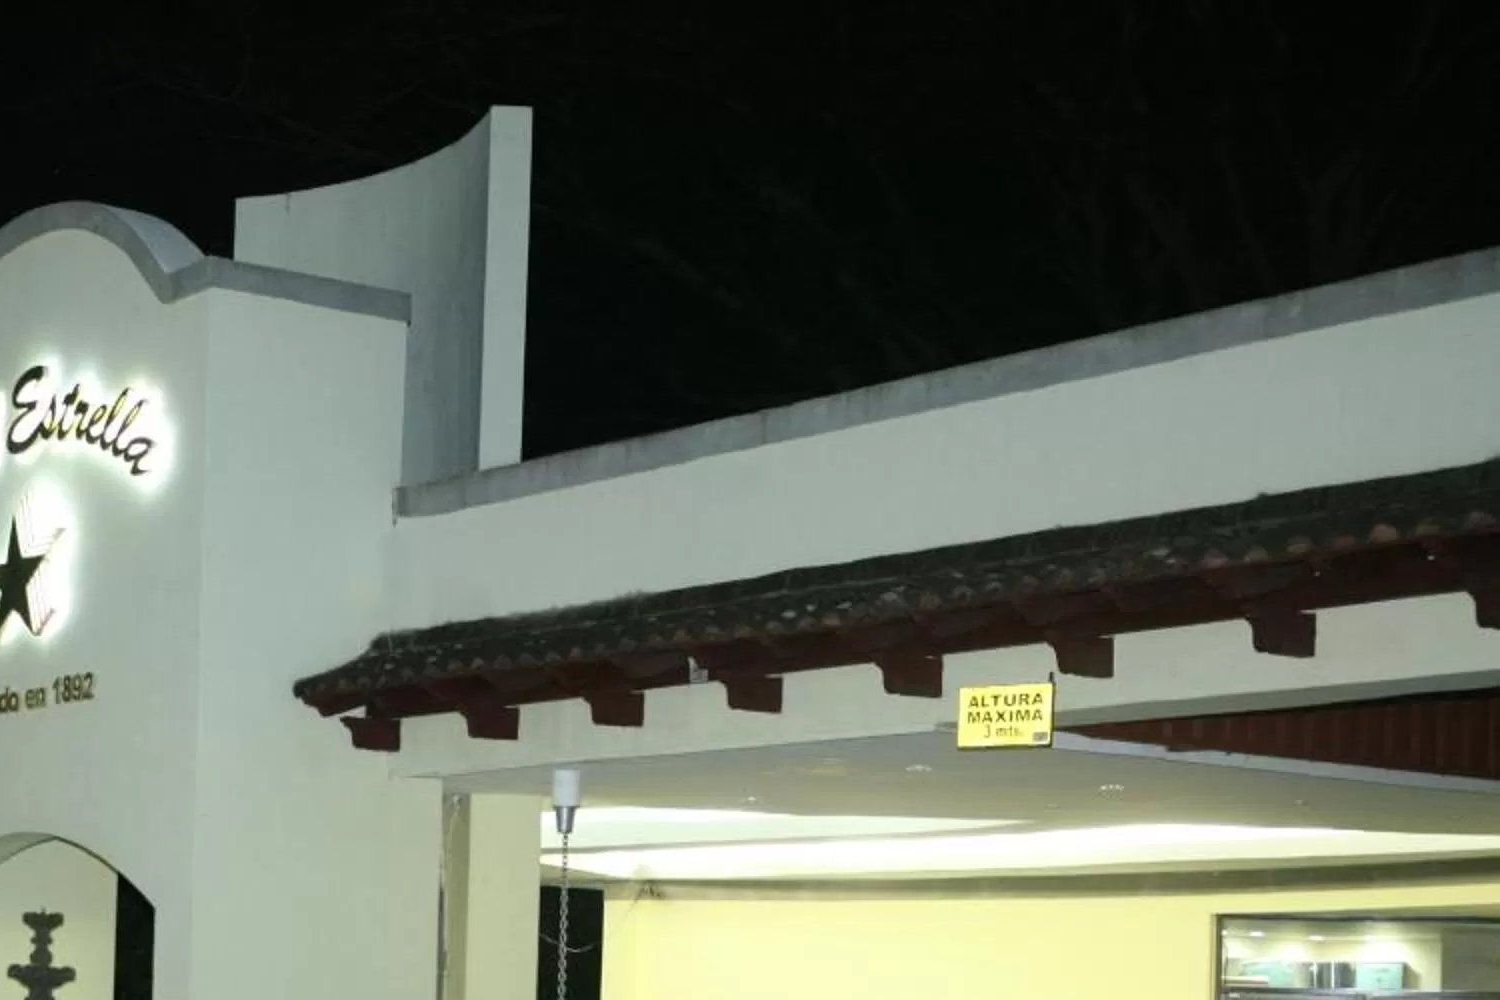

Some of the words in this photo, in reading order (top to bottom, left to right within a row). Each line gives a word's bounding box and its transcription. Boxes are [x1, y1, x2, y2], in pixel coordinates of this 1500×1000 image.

[7, 365, 155, 476] Estrella
[25, 688, 46, 706] en
[52, 672, 95, 702] 1892
[968, 693, 1043, 708] ALTURA
[967, 709, 1043, 724] MAXIMA
